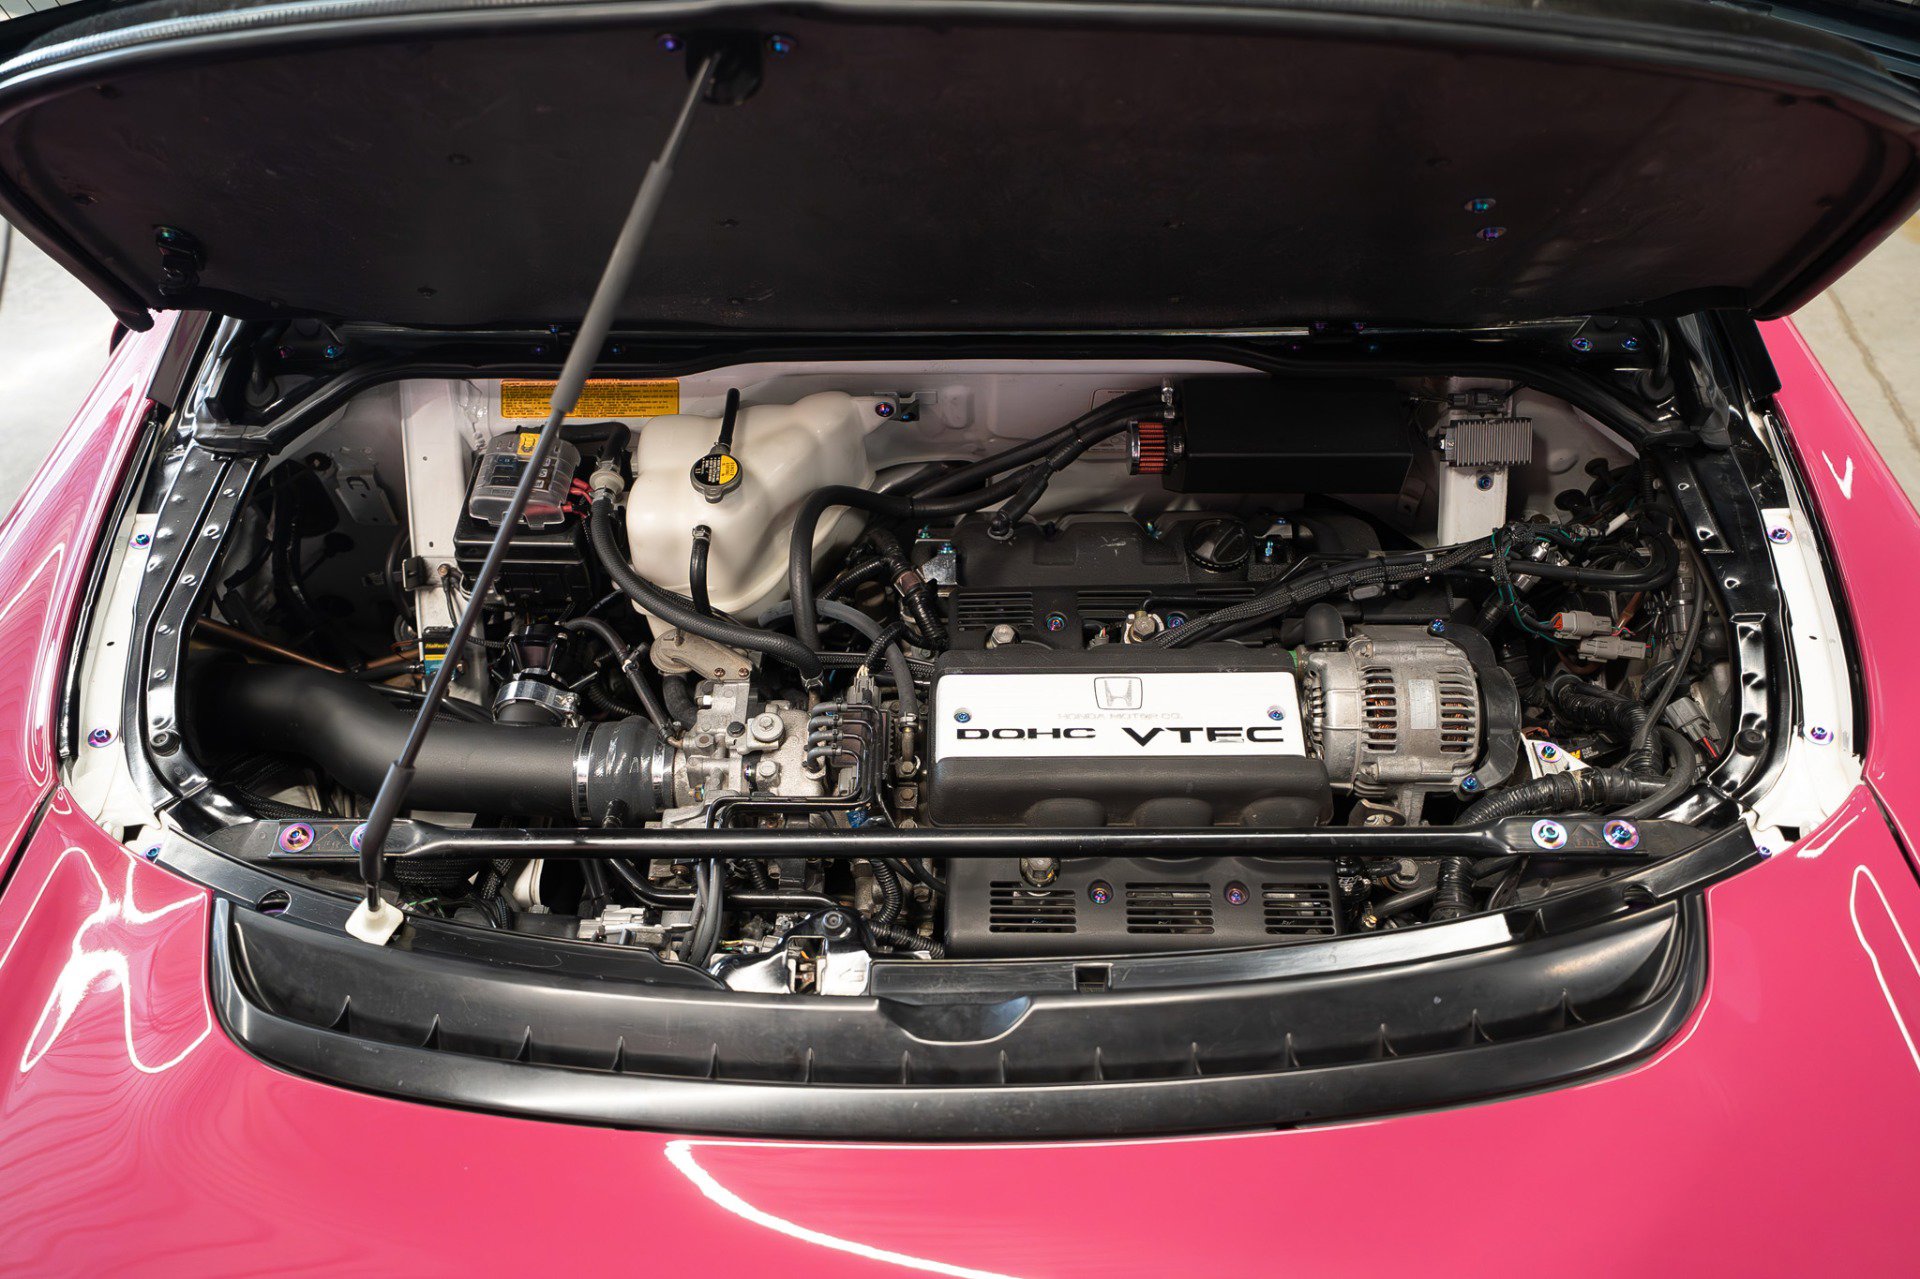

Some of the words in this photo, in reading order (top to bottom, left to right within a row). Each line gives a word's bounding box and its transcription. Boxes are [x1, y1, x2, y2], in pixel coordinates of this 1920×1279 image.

[1057, 712, 1105, 720] HONDA
[956, 727, 1096, 740] DOHC
[1121, 726, 1284, 747] VTEC
